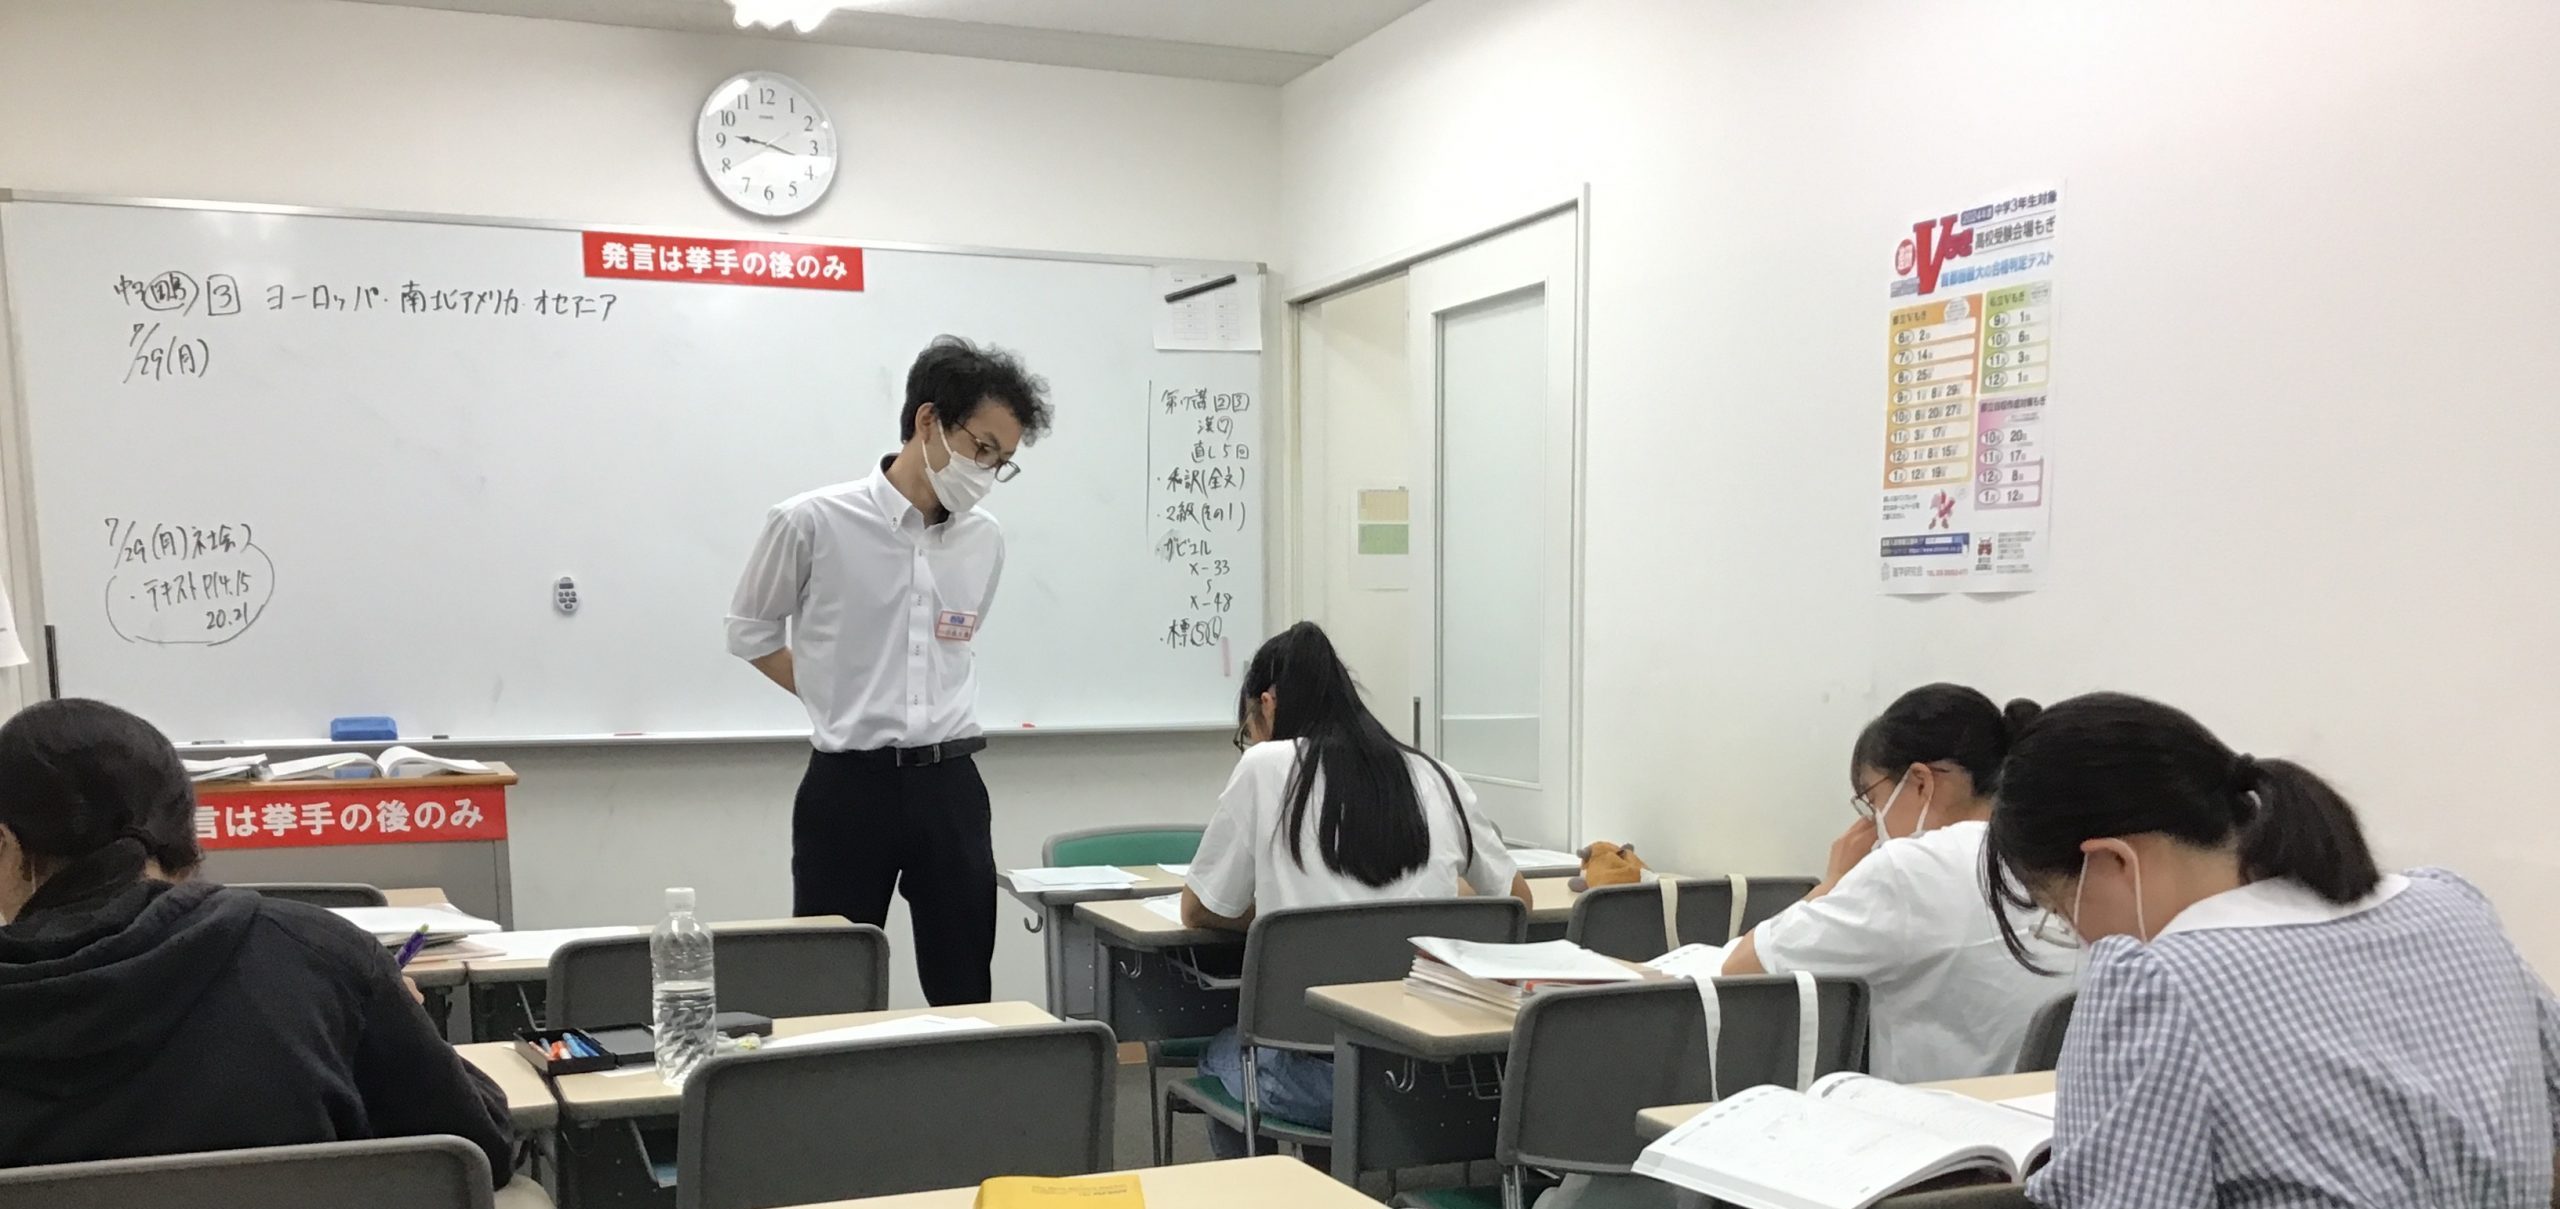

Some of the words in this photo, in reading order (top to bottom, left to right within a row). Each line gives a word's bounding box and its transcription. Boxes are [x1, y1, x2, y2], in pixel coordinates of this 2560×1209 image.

[737, 94, 750, 110] 11
[759, 87, 776, 105] 12
[789, 97, 795, 113] 1
[720, 110, 736, 127] 10
[803, 115, 813, 132] 2
[716, 132, 726, 148] 9
[809, 140, 819, 156] 3
[721, 157, 732, 174] 8
[804, 165, 814, 181] 4
[741, 176, 751, 193] 7
[764, 185, 775, 201] 6
[788, 181, 798, 197] 5
[1994, 190, 2058, 215] 中学3年生対象
[1975, 215, 2056, 251] 高校受験会場もぎ
[601, 241, 848, 281] 発言は挙手の後のみ
